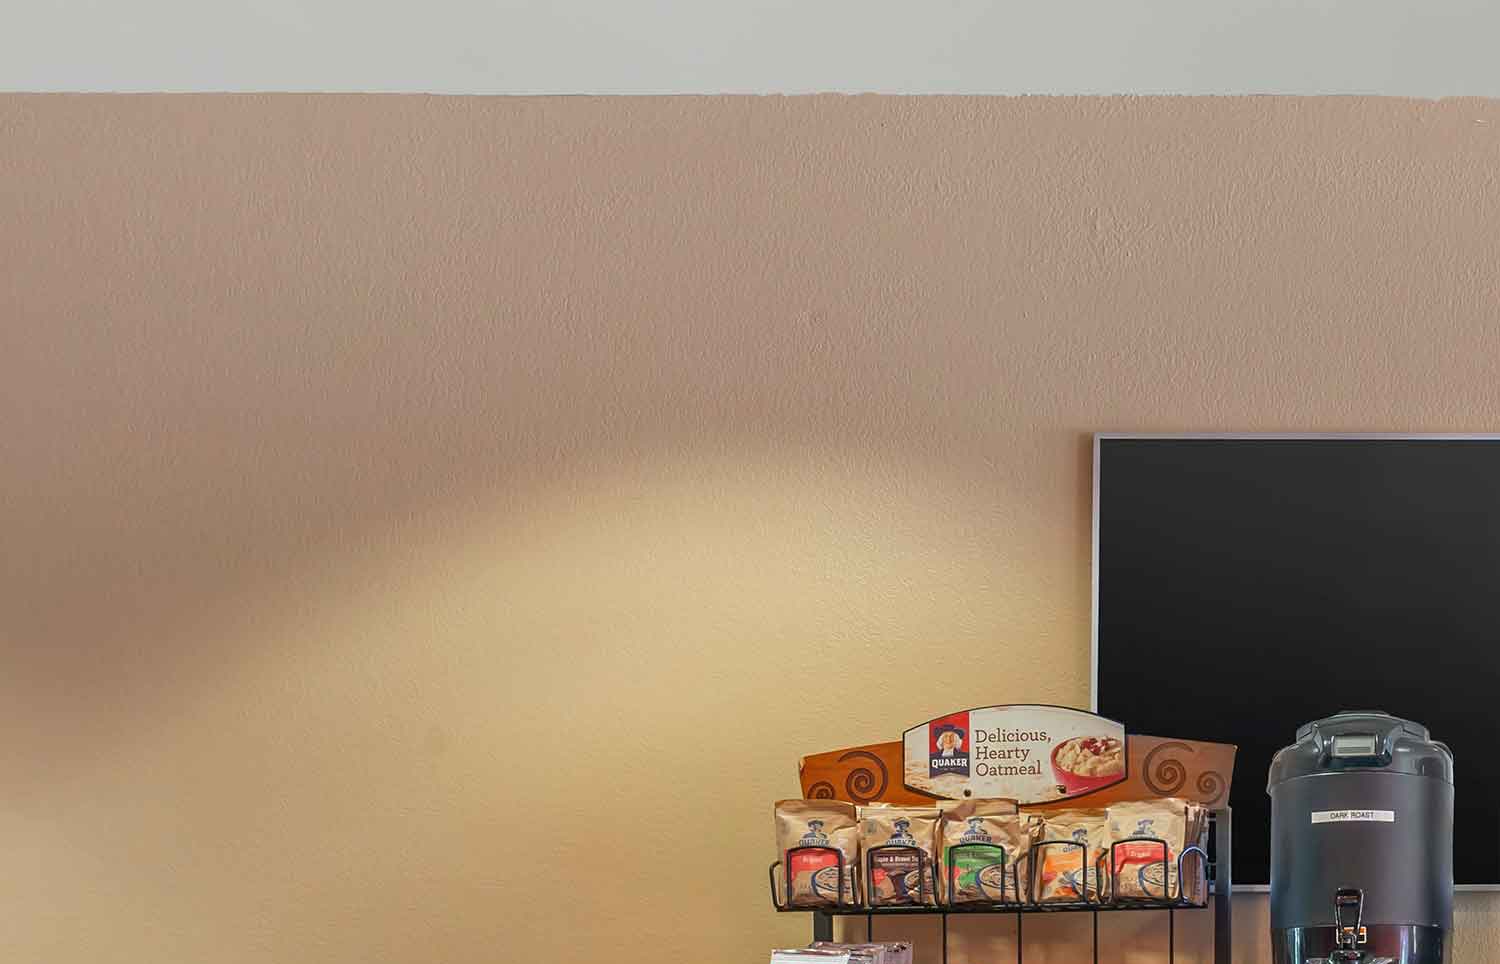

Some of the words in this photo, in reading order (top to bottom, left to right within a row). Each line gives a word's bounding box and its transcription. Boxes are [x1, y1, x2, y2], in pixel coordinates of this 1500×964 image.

[975, 728, 1051, 744] Delicious,
[975, 746, 1030, 762] Hearty
[931, 757, 968, 768] QUAKER
[975, 760, 1041, 777] Oatmeal
[1330, 812, 1348, 820] DARK
[1350, 811, 1374, 819] ROAST
